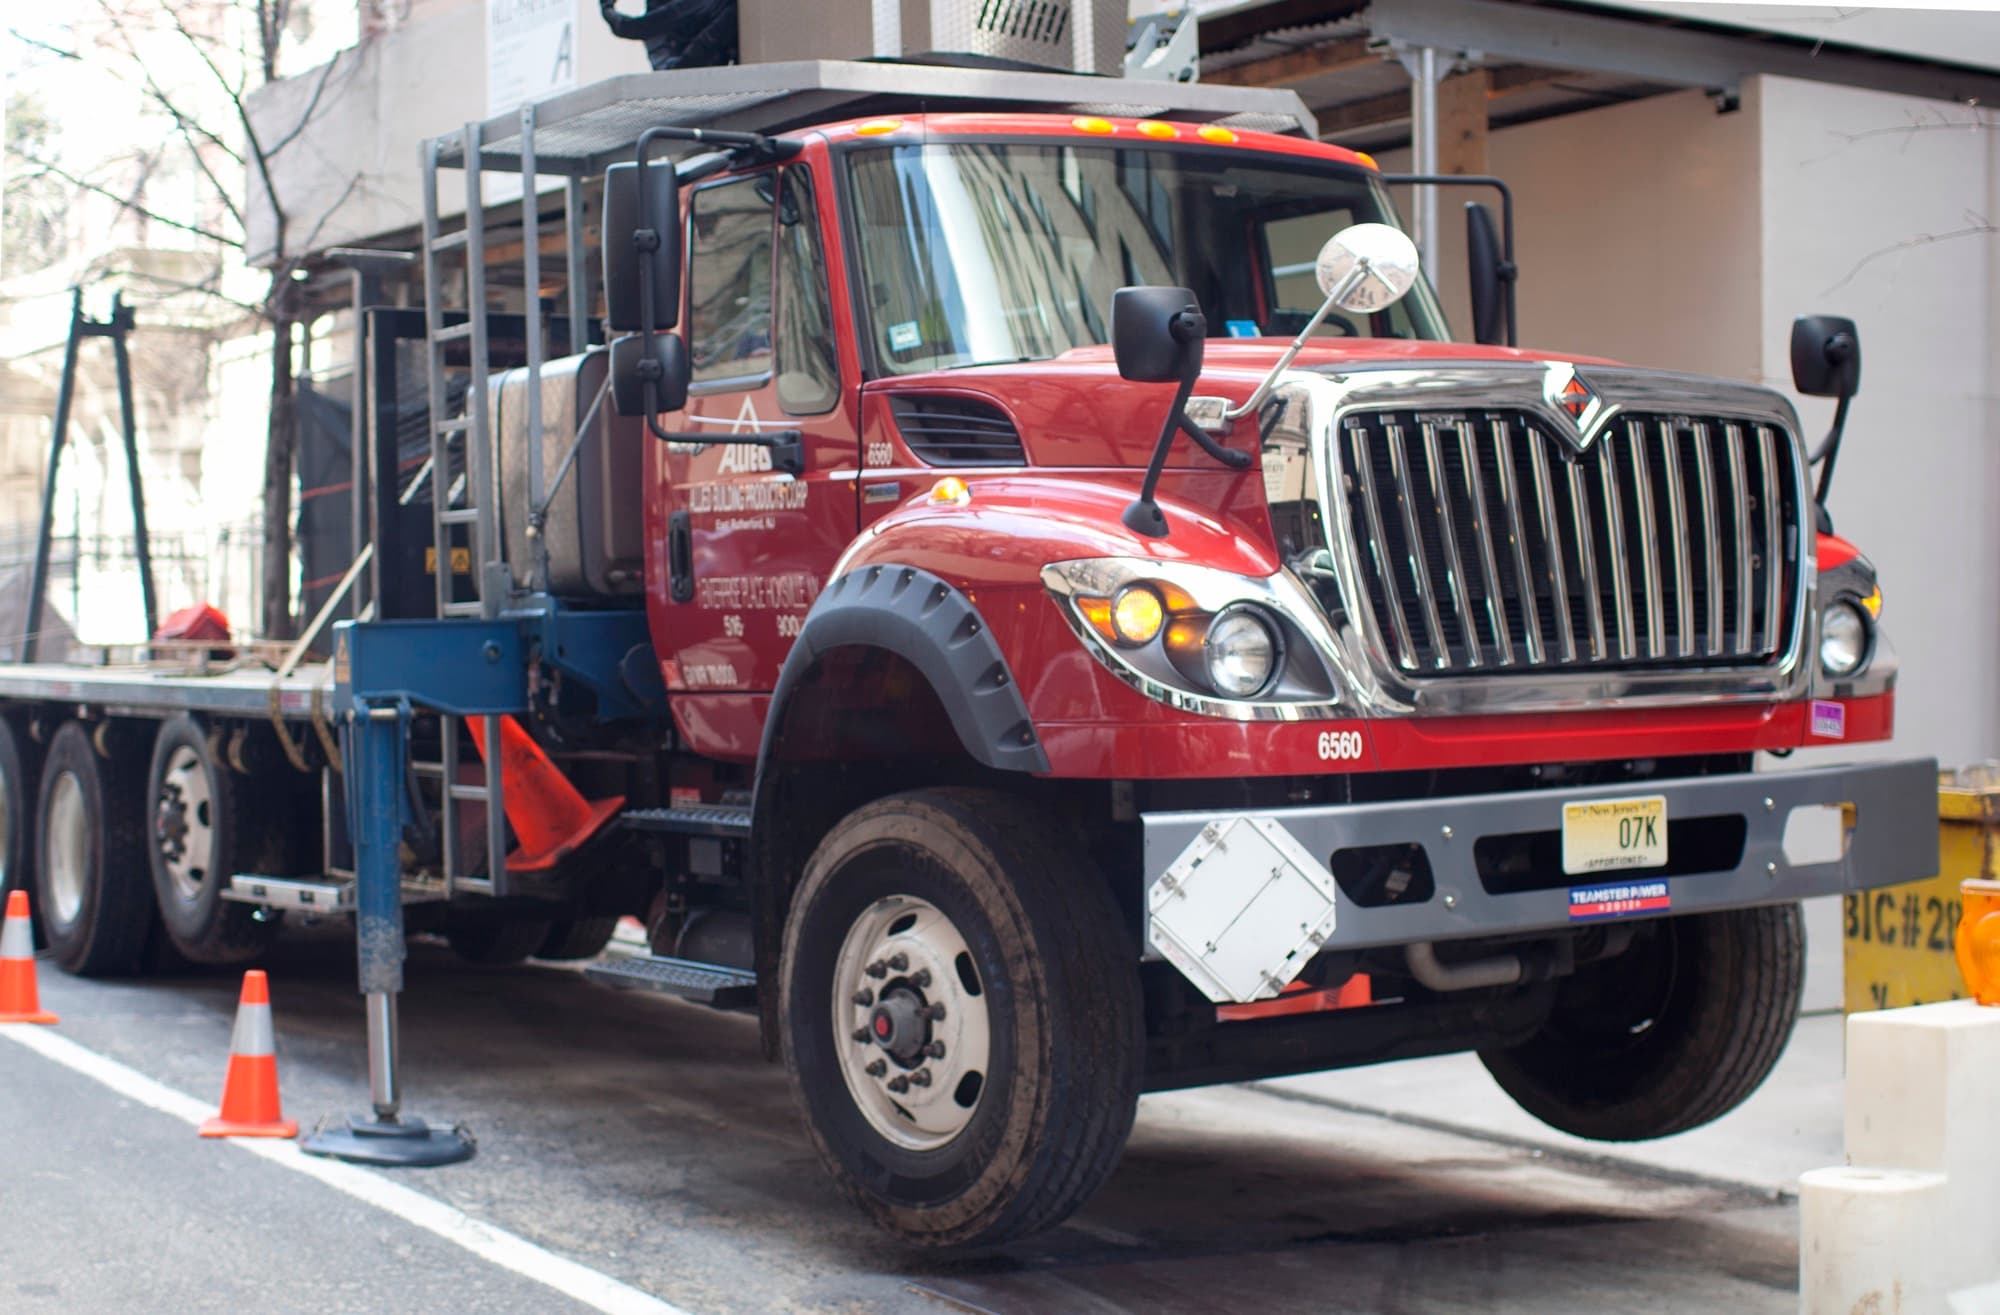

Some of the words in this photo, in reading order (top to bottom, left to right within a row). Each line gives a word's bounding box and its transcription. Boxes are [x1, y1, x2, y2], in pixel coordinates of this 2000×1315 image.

[551, 21, 572, 84] A
[1317, 731, 1363, 760] 6560
[1619, 815, 1657, 849] 07K
[1571, 888, 1629, 905] TEAMSTER
